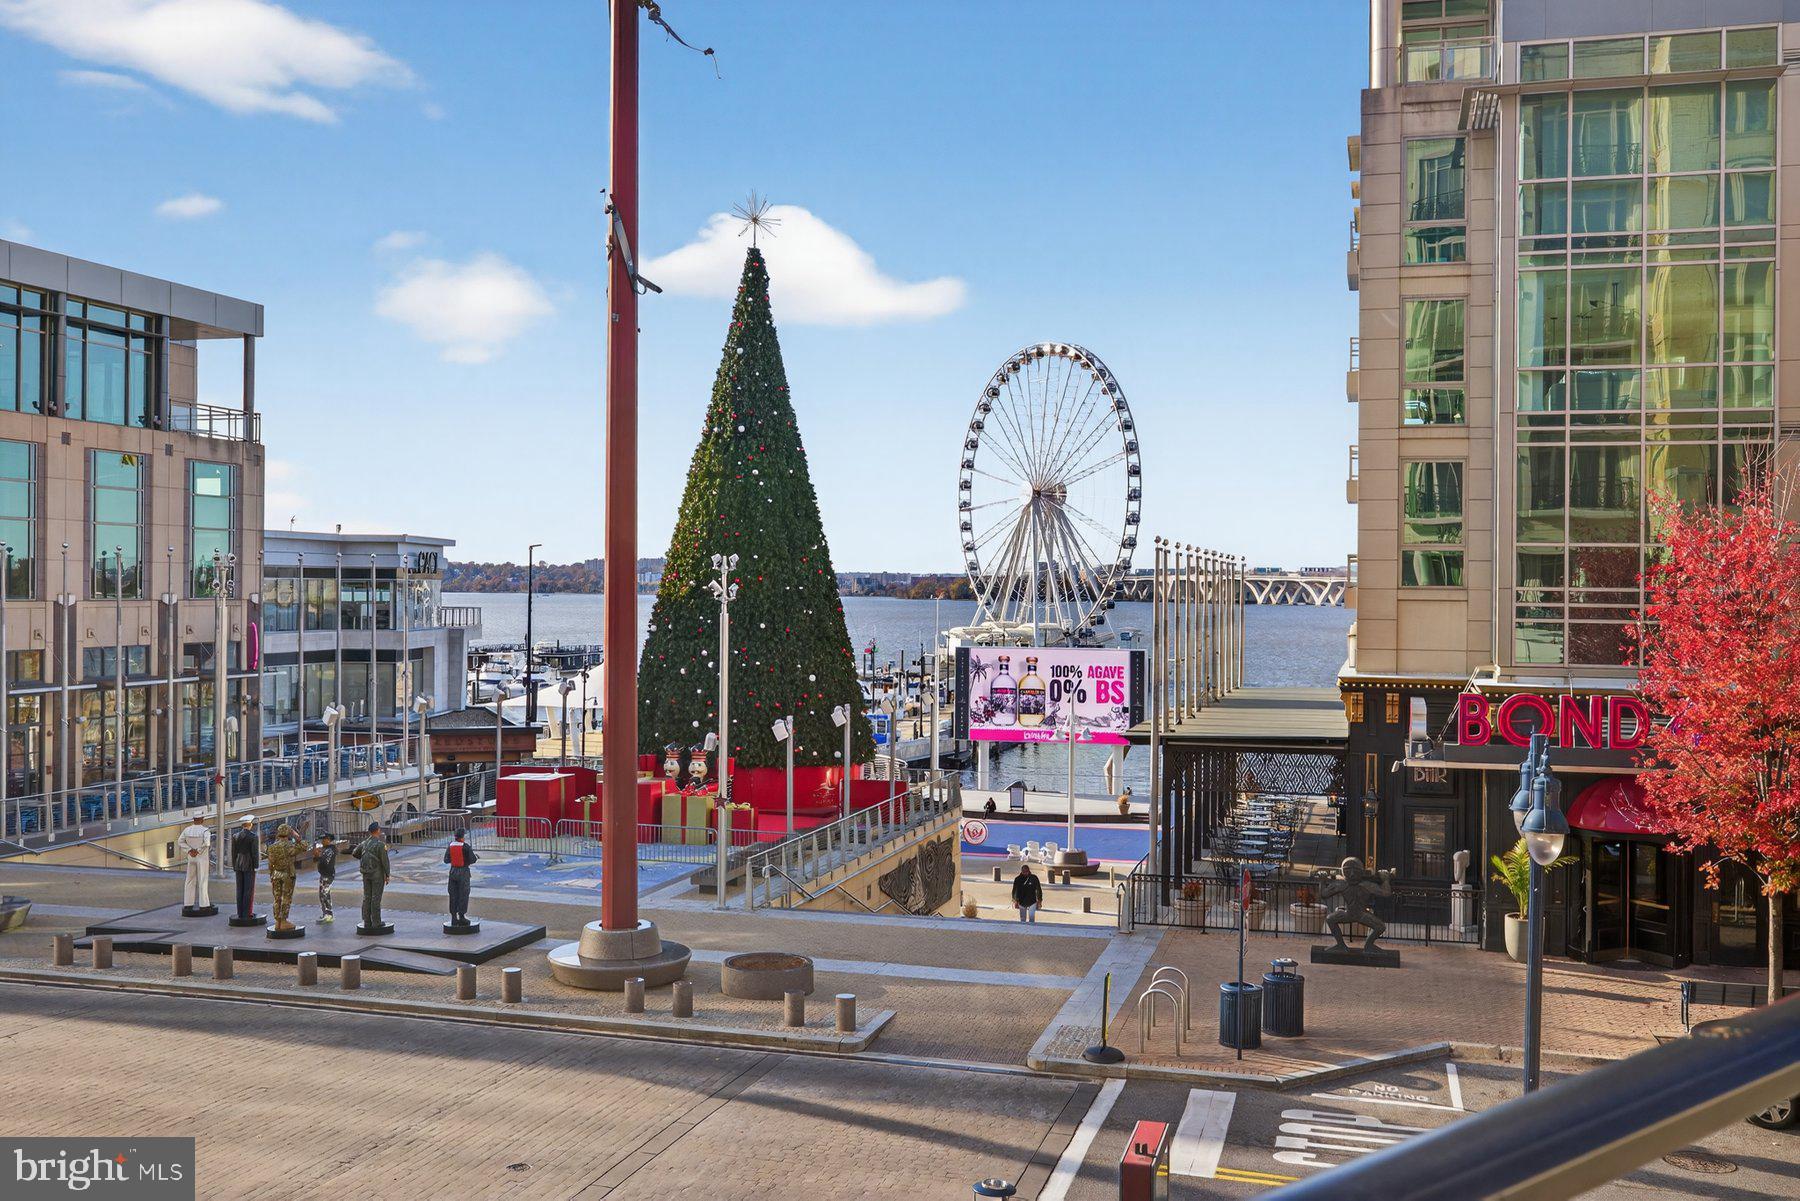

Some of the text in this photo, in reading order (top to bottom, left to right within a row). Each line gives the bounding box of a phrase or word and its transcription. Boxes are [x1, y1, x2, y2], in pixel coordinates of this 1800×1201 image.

[1050, 665, 1125, 679] 100% AGAVE
[1049, 679, 1125, 705] 0% BS
[1458, 692, 1651, 750] BOND
[1348, 1089, 1430, 1102] PARKING
[1374, 1084, 1399, 1093] NO
